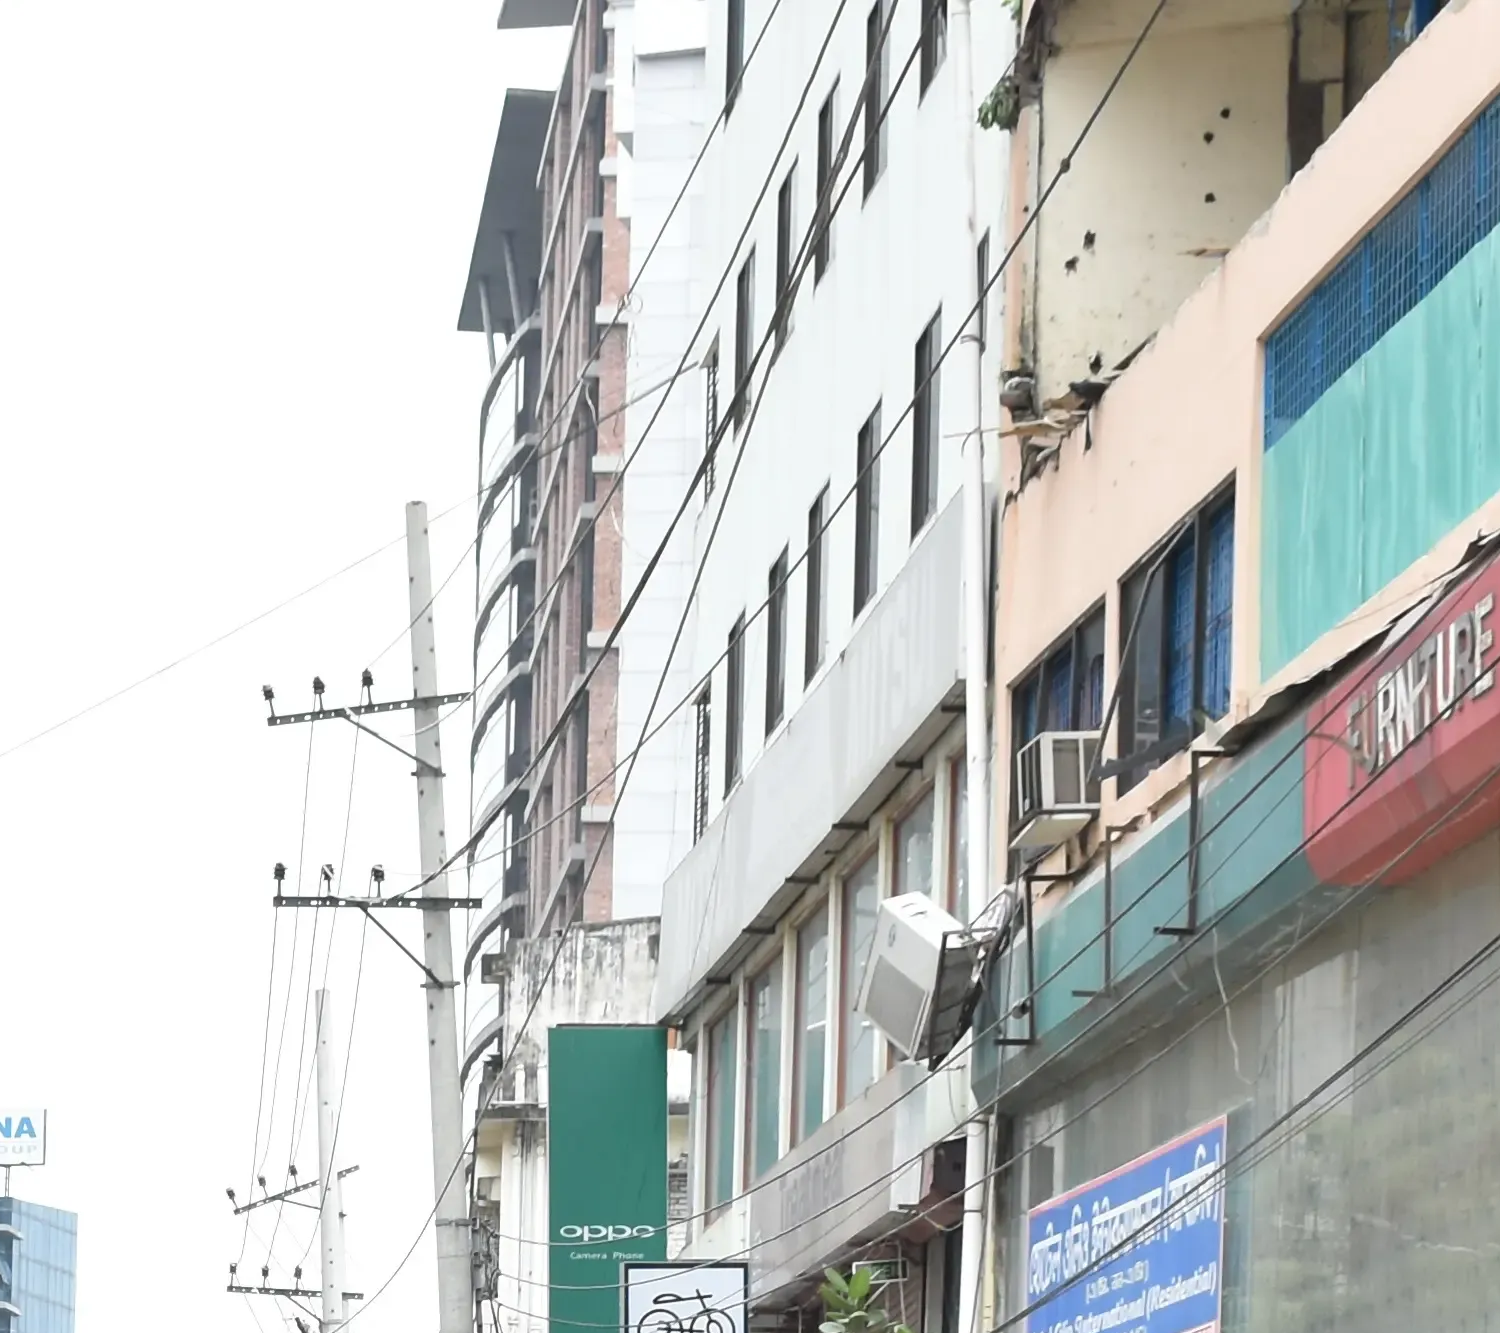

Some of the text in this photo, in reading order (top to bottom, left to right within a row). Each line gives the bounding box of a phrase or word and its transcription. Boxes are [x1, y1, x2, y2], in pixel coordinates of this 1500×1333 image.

[559, 1224, 656, 1242] oppo
[569, 1251, 645, 1261] Camera Phone
